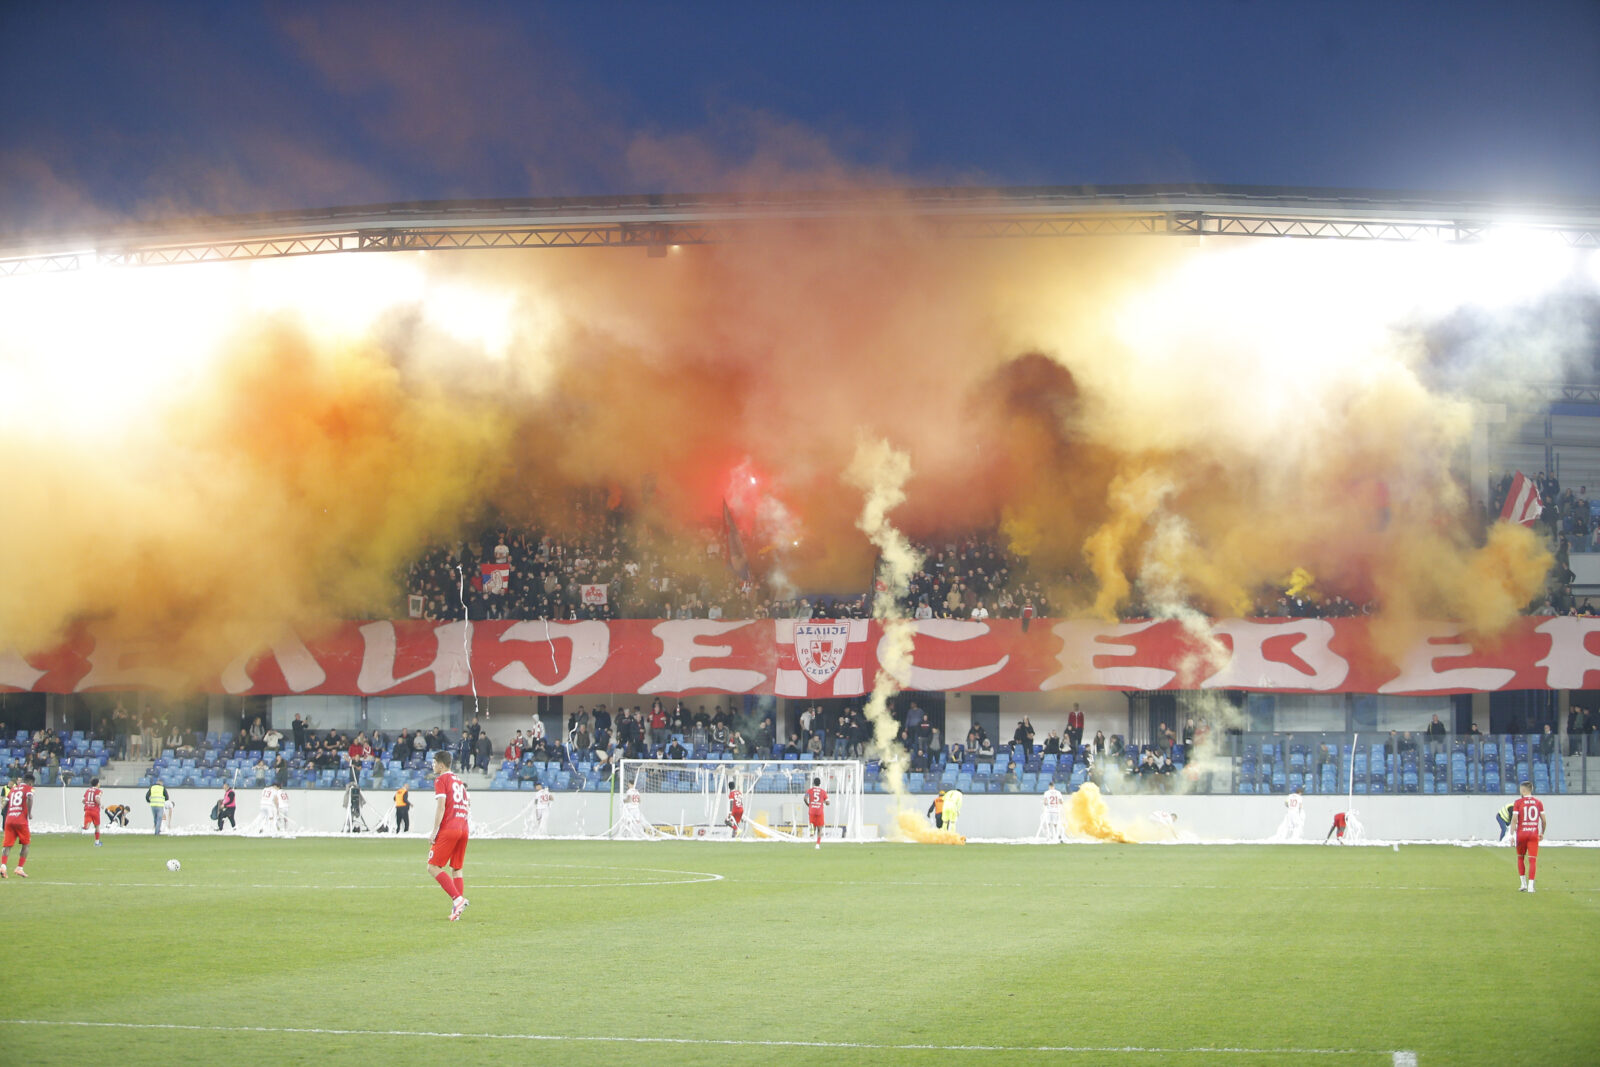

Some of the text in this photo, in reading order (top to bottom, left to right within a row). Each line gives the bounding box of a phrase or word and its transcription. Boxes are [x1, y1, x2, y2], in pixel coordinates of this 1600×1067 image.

[10, 791, 24, 806] 18
[87, 791, 95, 801] 11
[263, 790, 272, 798] 13
[452, 782, 469, 804] 80
[813, 791, 820, 802] 5
[1049, 796, 1058, 805] 21
[1523, 805, 1538, 821] 10
